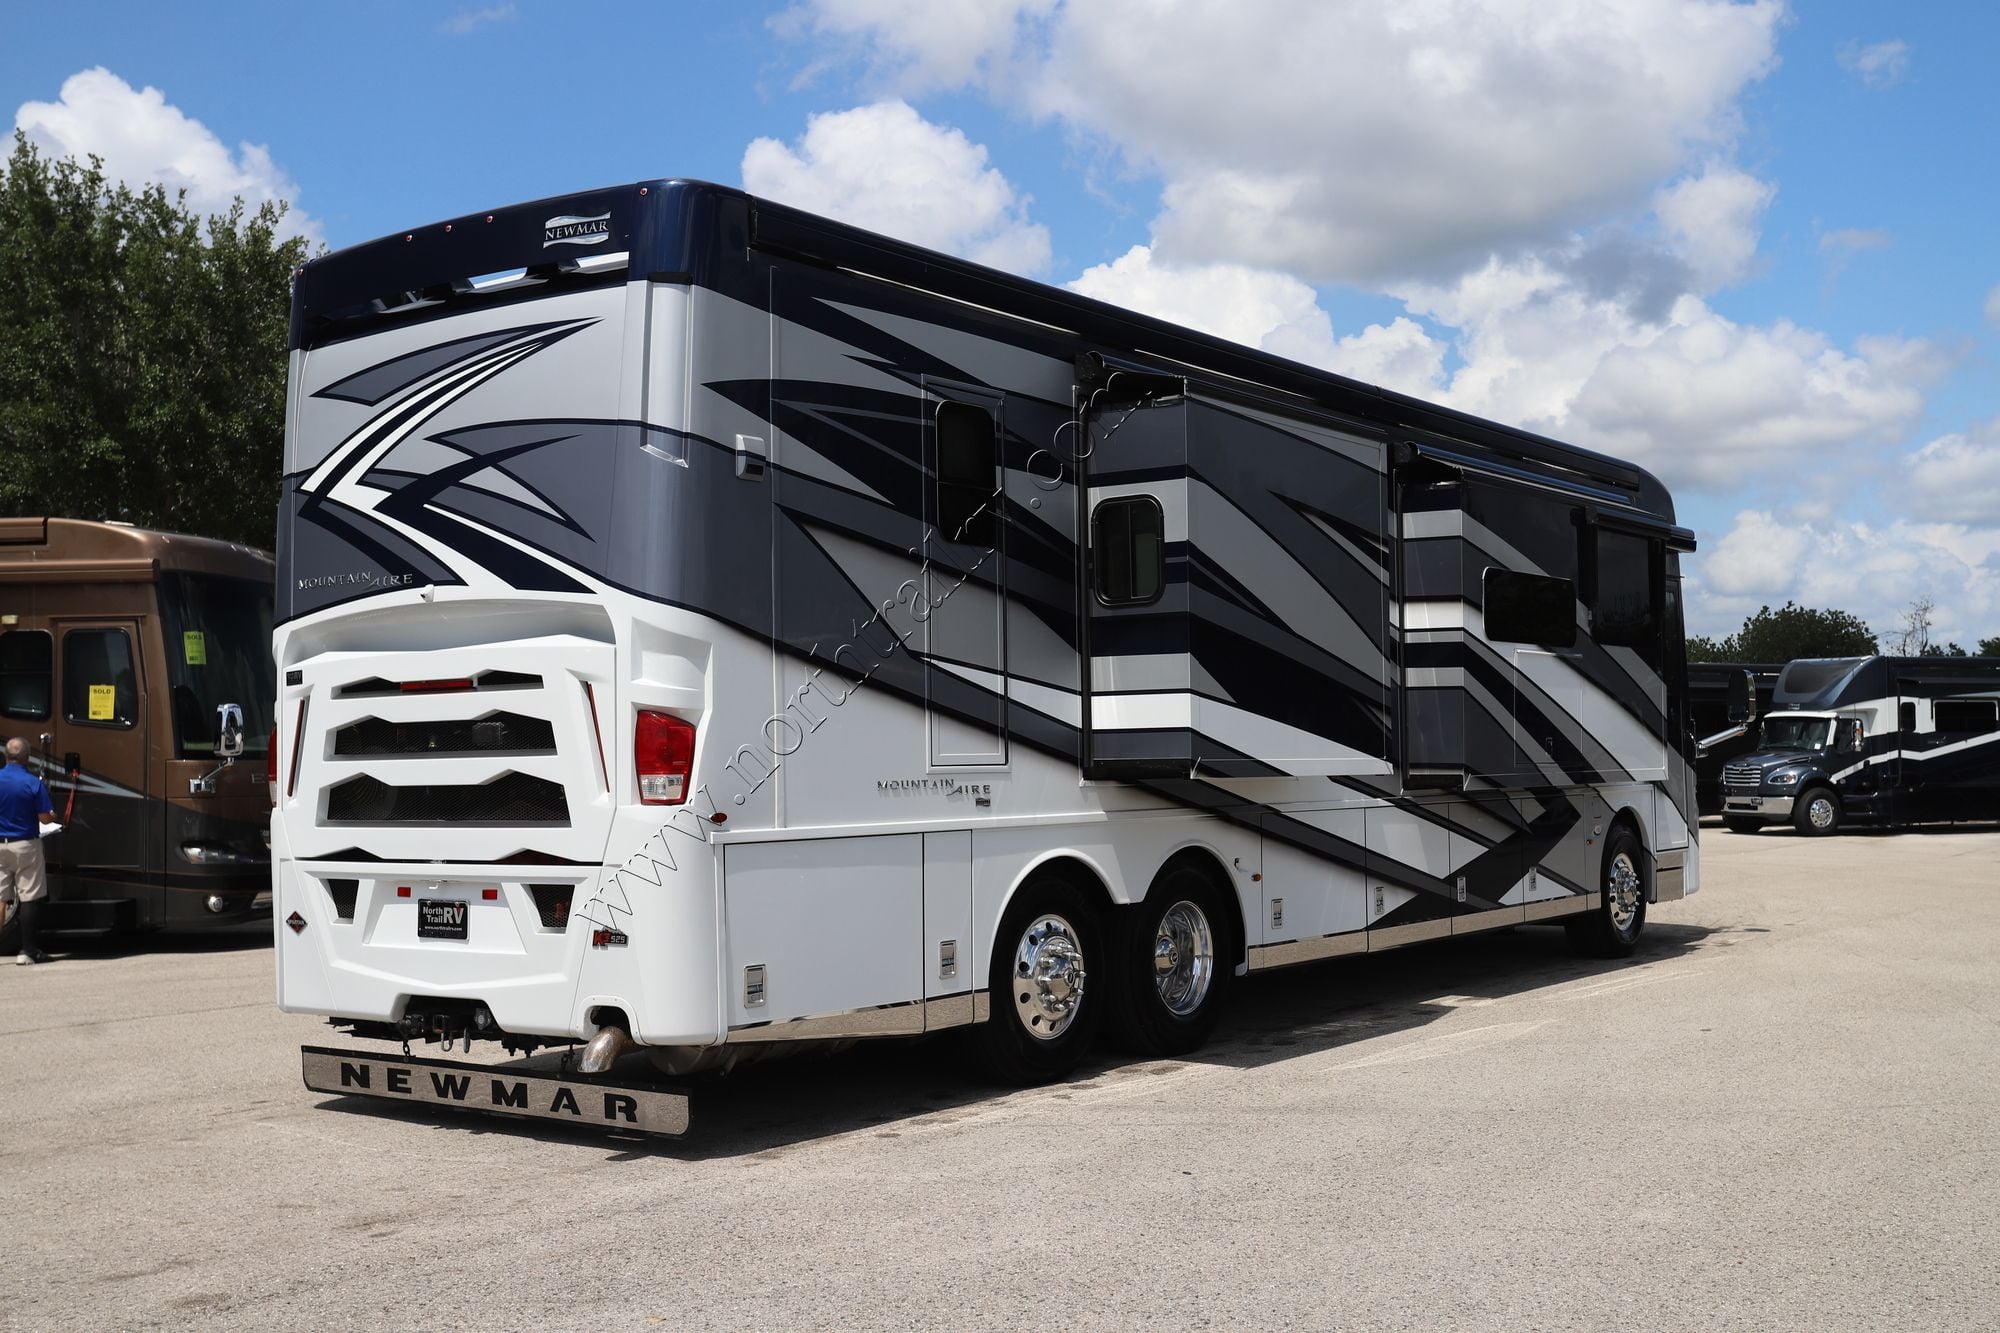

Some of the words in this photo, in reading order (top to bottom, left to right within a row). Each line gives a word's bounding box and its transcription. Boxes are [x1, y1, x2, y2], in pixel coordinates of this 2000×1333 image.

[545, 221, 609, 240] NEWMAR
[298, 571, 371, 589] MOUNTAIN
[362, 573, 413, 589] AIRE
[877, 778, 954, 791] MOUNTAIN
[946, 784, 991, 797] AIRE
[422, 906, 443, 915] North
[426, 914, 443, 924] Trail
[443, 906, 465, 924] RV
[340, 1061, 639, 1124] NEWMAR
